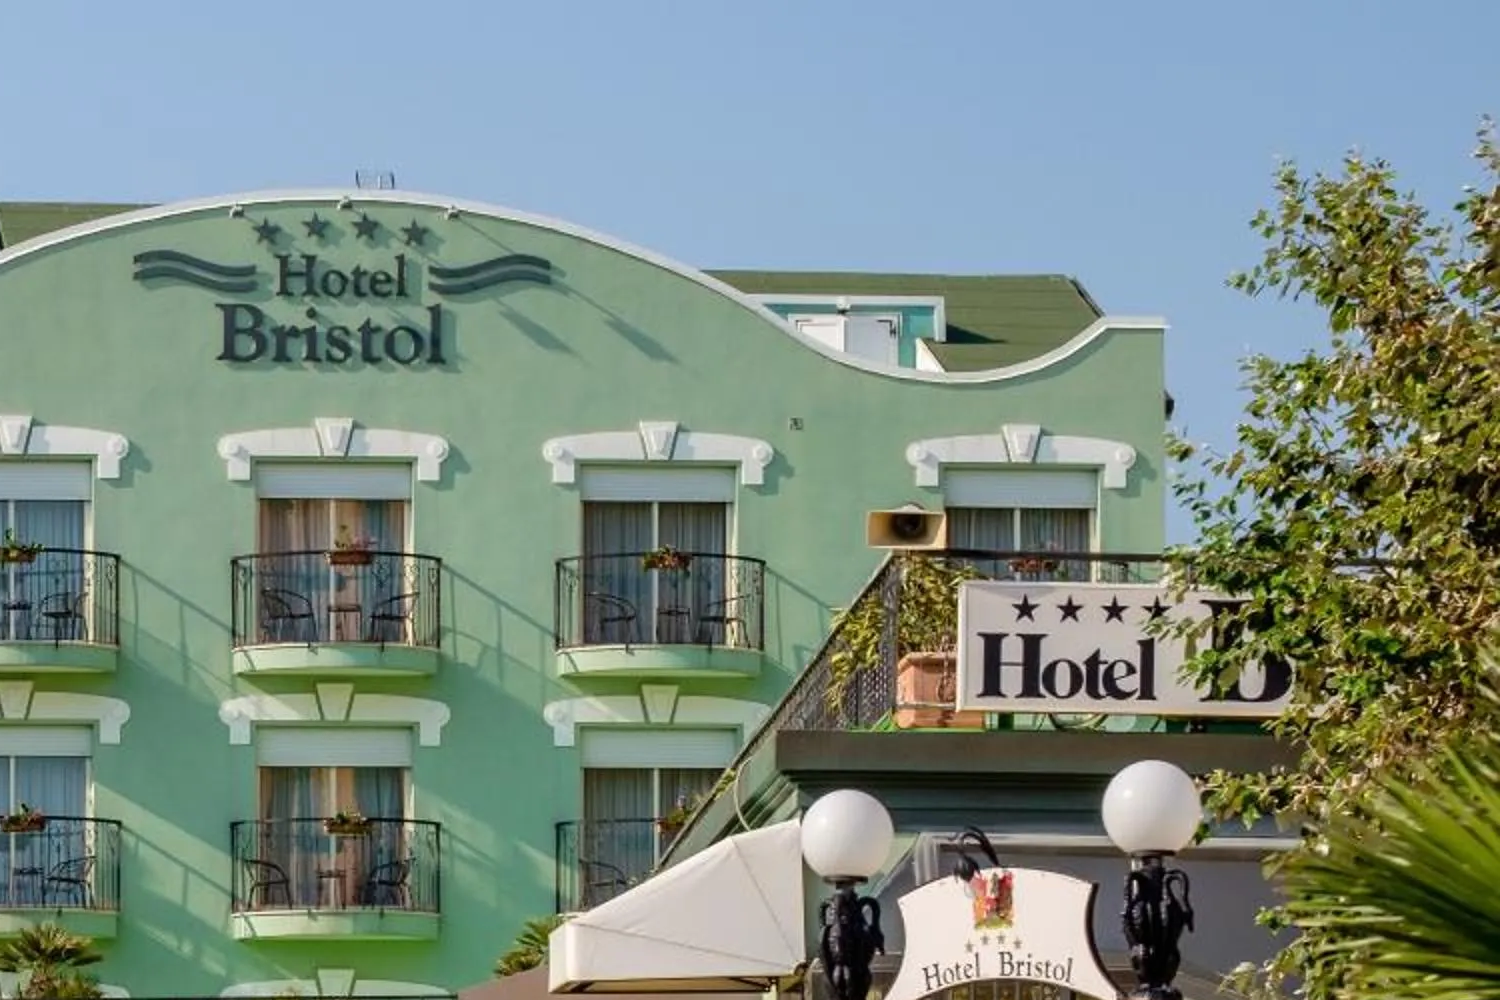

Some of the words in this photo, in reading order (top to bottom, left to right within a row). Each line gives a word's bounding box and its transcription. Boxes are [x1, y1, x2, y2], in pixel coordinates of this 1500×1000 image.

[275, 253, 410, 298] Hotel
[215, 303, 447, 365] Bristol
[976, 632, 1158, 701] Hotel
[922, 952, 982, 992] Hotel
[997, 951, 1074, 985] Bristol
